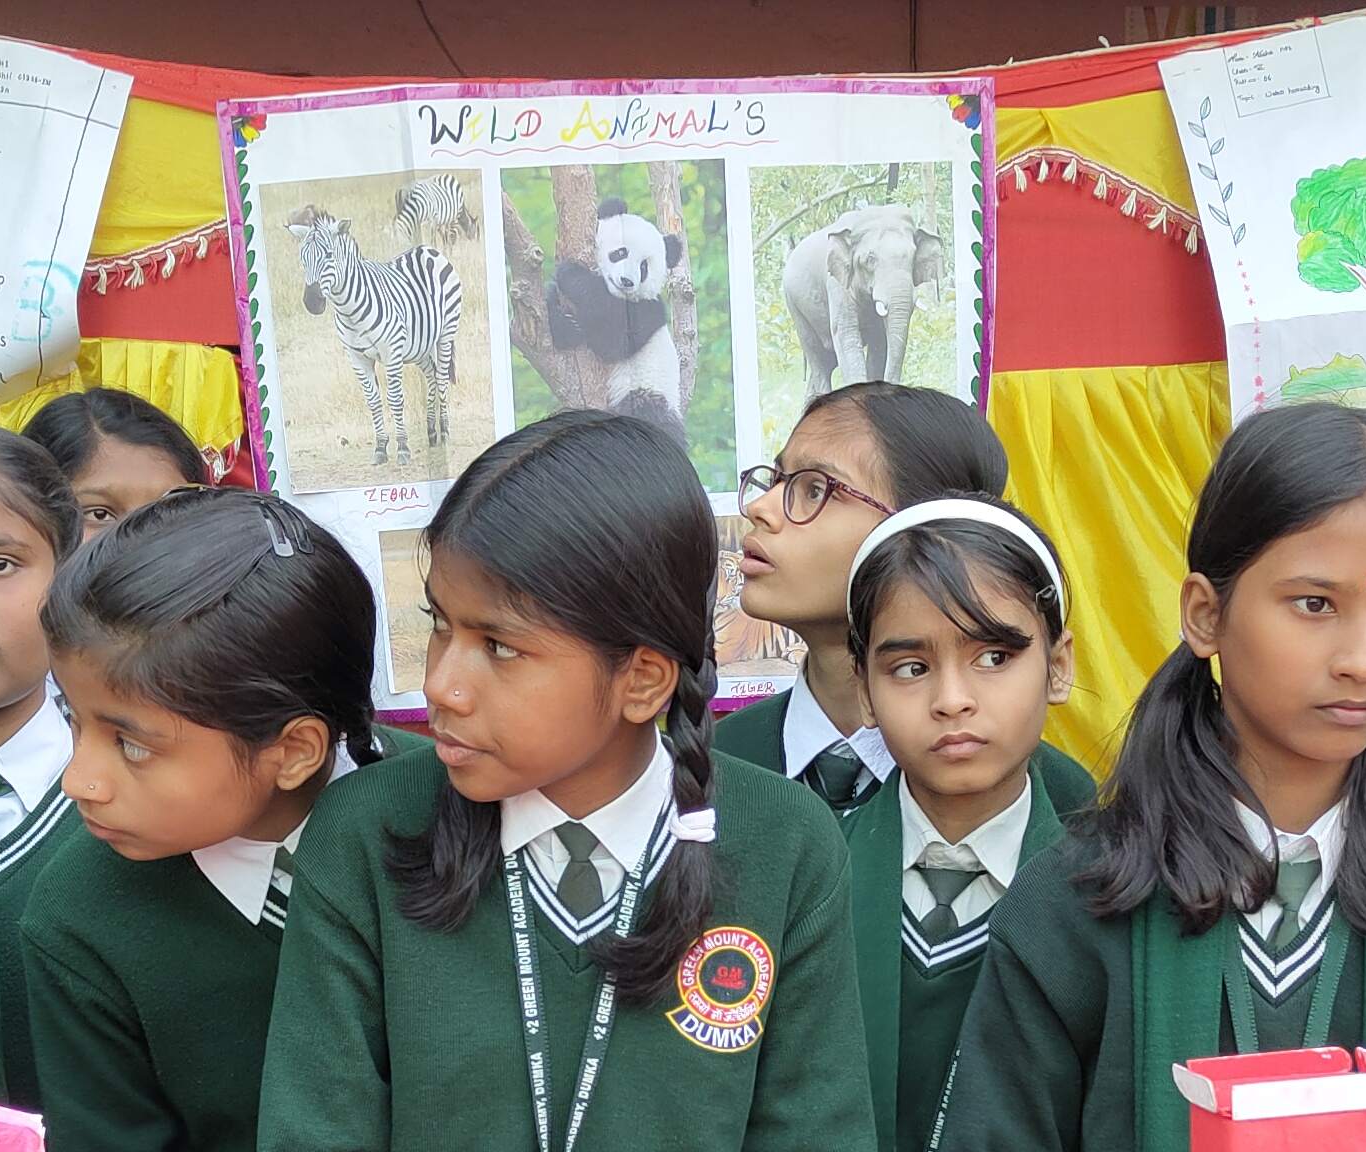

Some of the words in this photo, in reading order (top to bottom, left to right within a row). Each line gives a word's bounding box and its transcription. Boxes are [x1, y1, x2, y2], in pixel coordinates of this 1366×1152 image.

[364, 487, 419, 502] ZEBRA
[731, 681, 775, 694] TIGER
[516, 932, 533, 974] MOUNT
[703, 932, 749, 950] MOUNT
[746, 941, 770, 1001] ACADEMY
[522, 976, 539, 1017] GREEN
[596, 983, 616, 1024] GREEN
[680, 1013, 756, 1048] DUMKA
[530, 1052, 545, 1095] DUMKA
[578, 1057, 600, 1100] DUMKA
